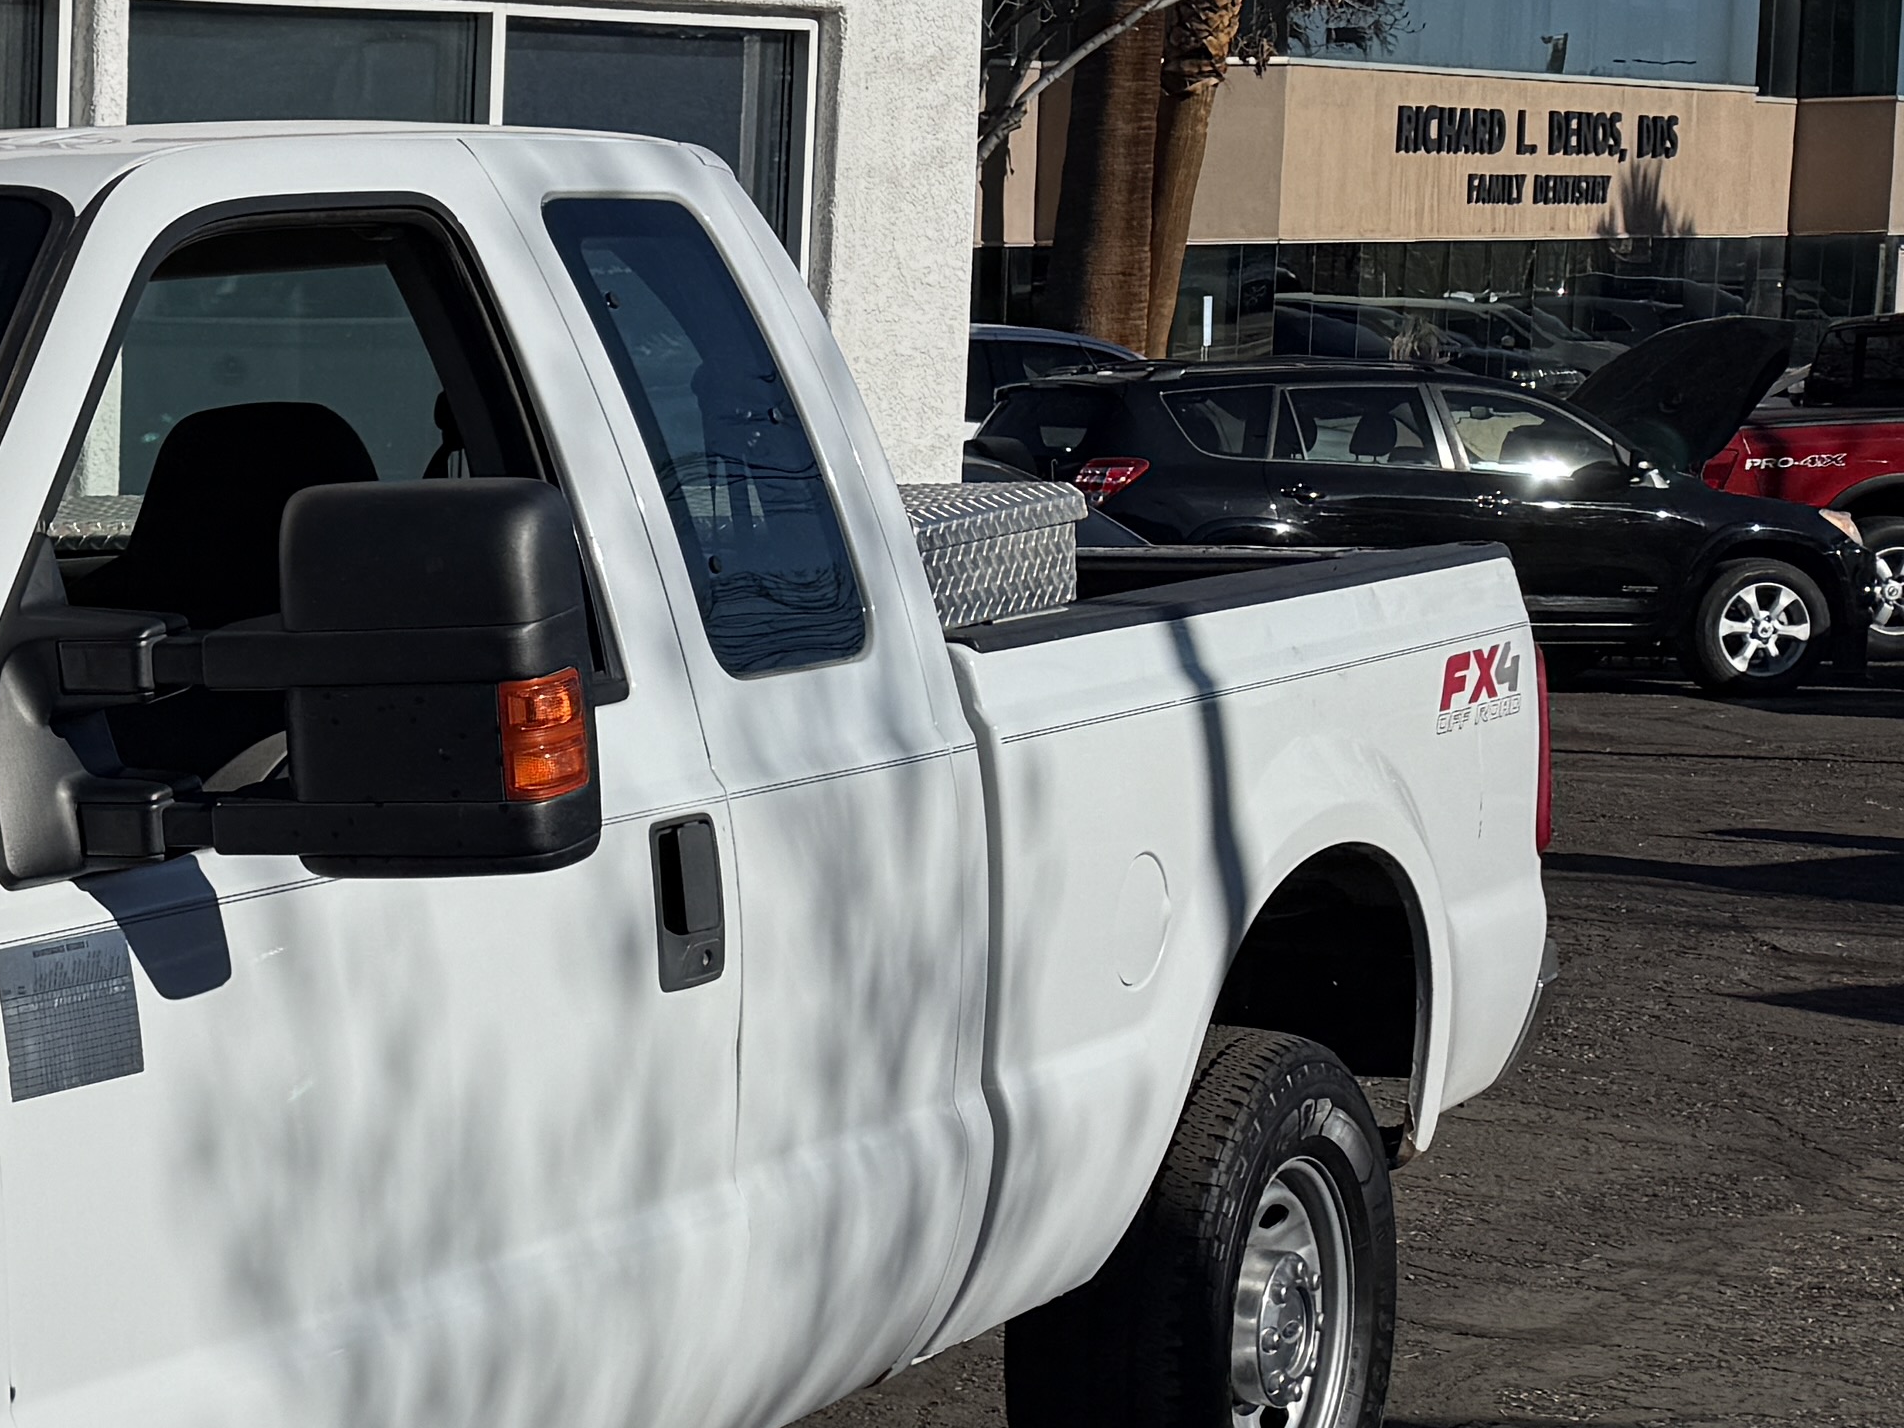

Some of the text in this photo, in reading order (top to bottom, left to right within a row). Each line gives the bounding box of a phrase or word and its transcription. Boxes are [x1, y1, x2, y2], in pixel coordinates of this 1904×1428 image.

[1395, 105, 1680, 164] RICHARD L. DENOS, DDS
[1467, 173, 1612, 206] FAMILY DENTISTRY
[1744, 452, 1848, 471] PRO-4X
[1439, 641, 1520, 712] FX4
[1436, 693, 1522, 735] OFF ROAD
